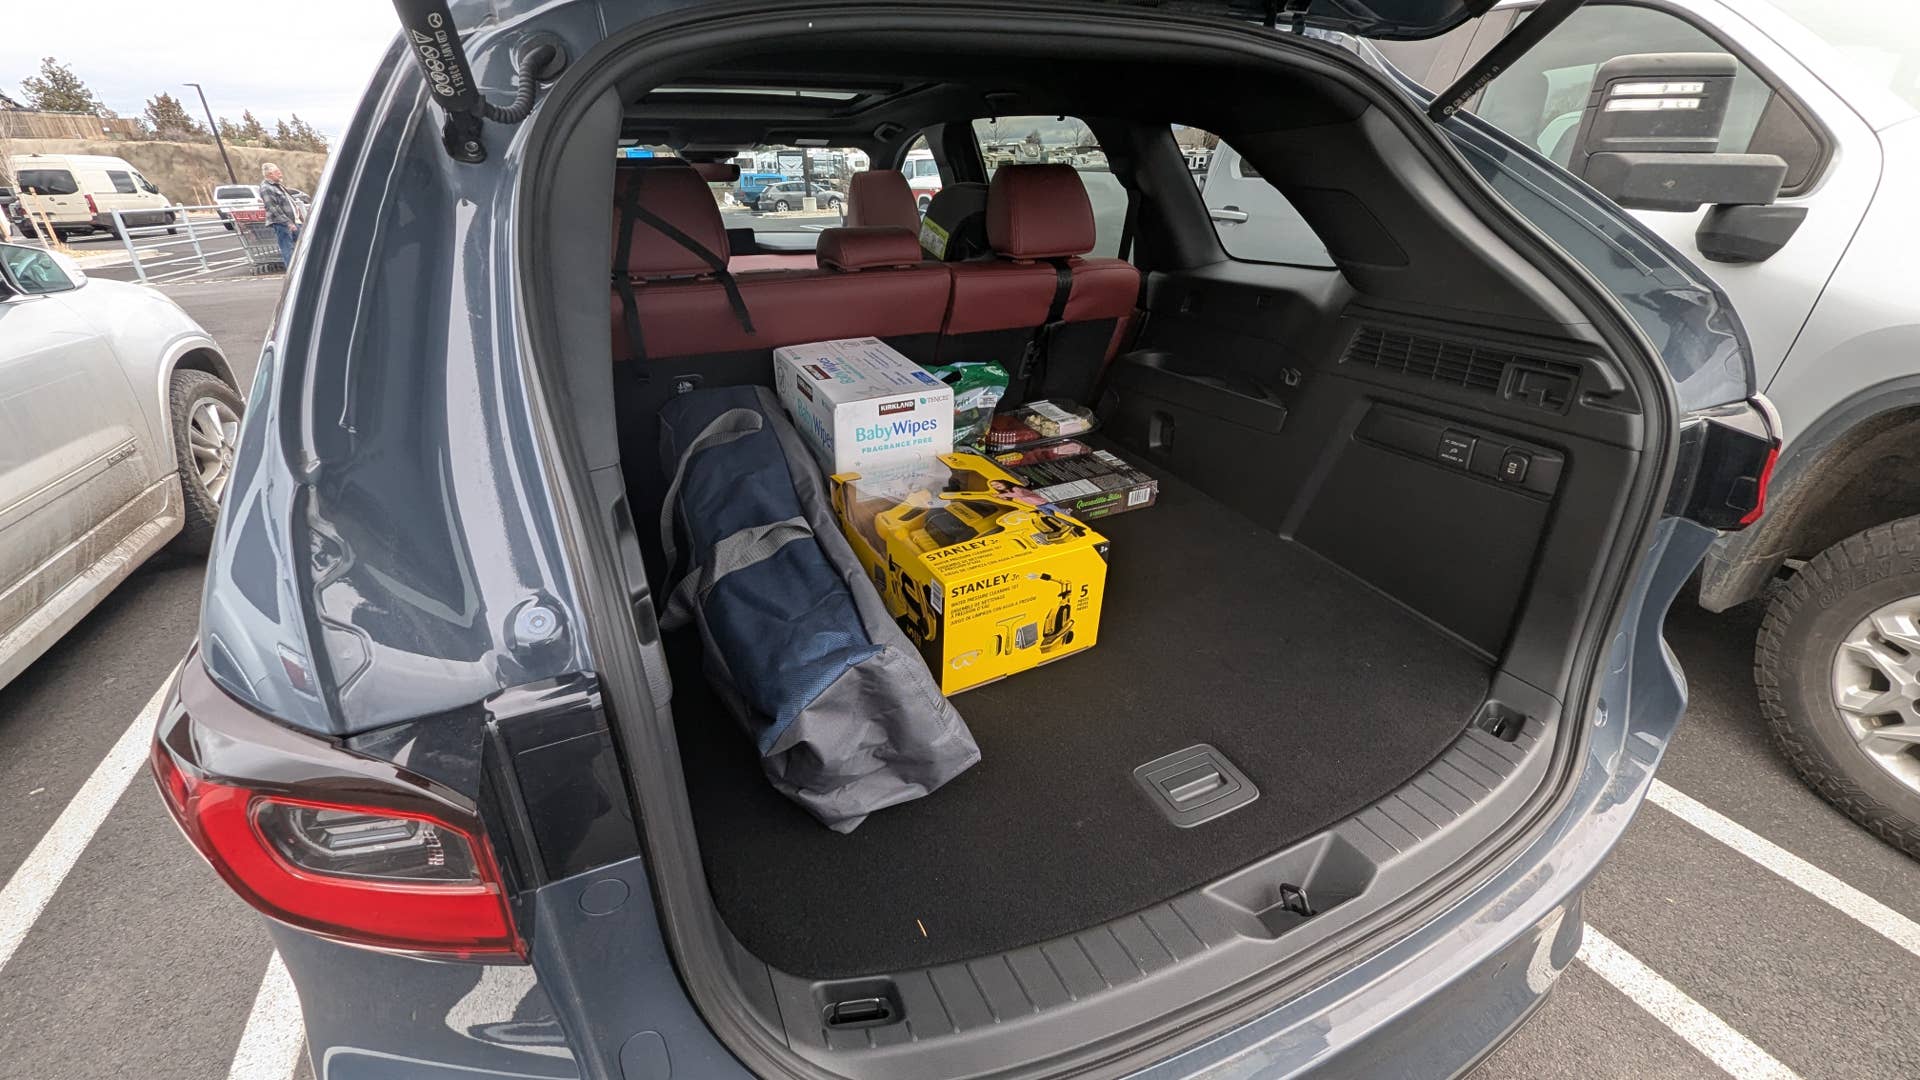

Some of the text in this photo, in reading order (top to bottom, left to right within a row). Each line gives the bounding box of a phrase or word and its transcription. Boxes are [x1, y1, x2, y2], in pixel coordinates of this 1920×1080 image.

[880, 400, 914, 412] KIRKLAND
[861, 436, 933, 454] FRAGRANCE FREE
[926, 539, 988, 562] STANLEY
[951, 572, 1010, 598] STANLEY
[1080, 584, 1089, 597] 5
